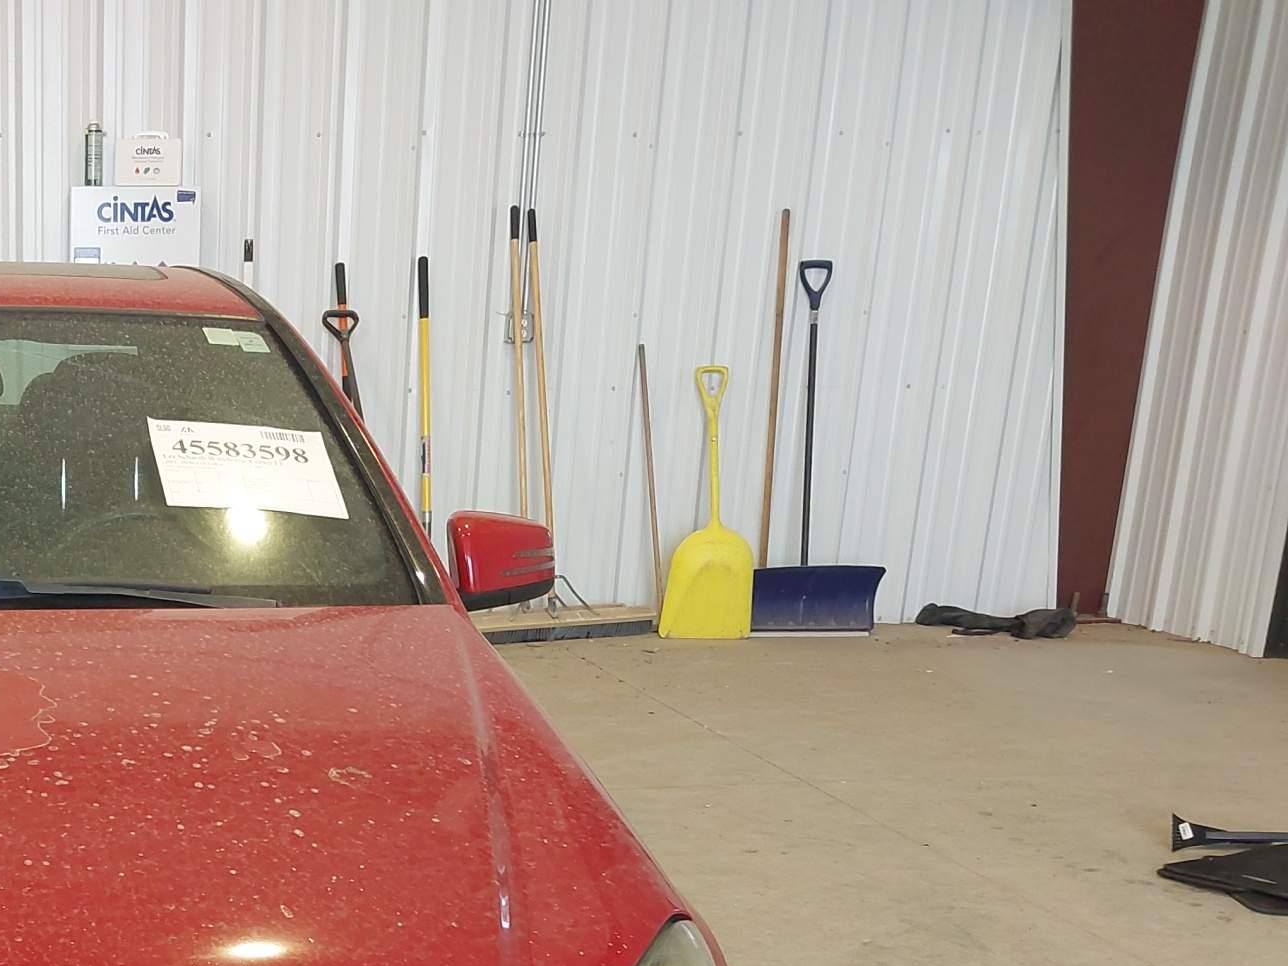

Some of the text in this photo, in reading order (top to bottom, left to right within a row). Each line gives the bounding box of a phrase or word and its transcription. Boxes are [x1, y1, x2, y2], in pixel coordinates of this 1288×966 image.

[97, 225, 176, 236] First Aid Center
[171, 438, 310, 464] 45583598
